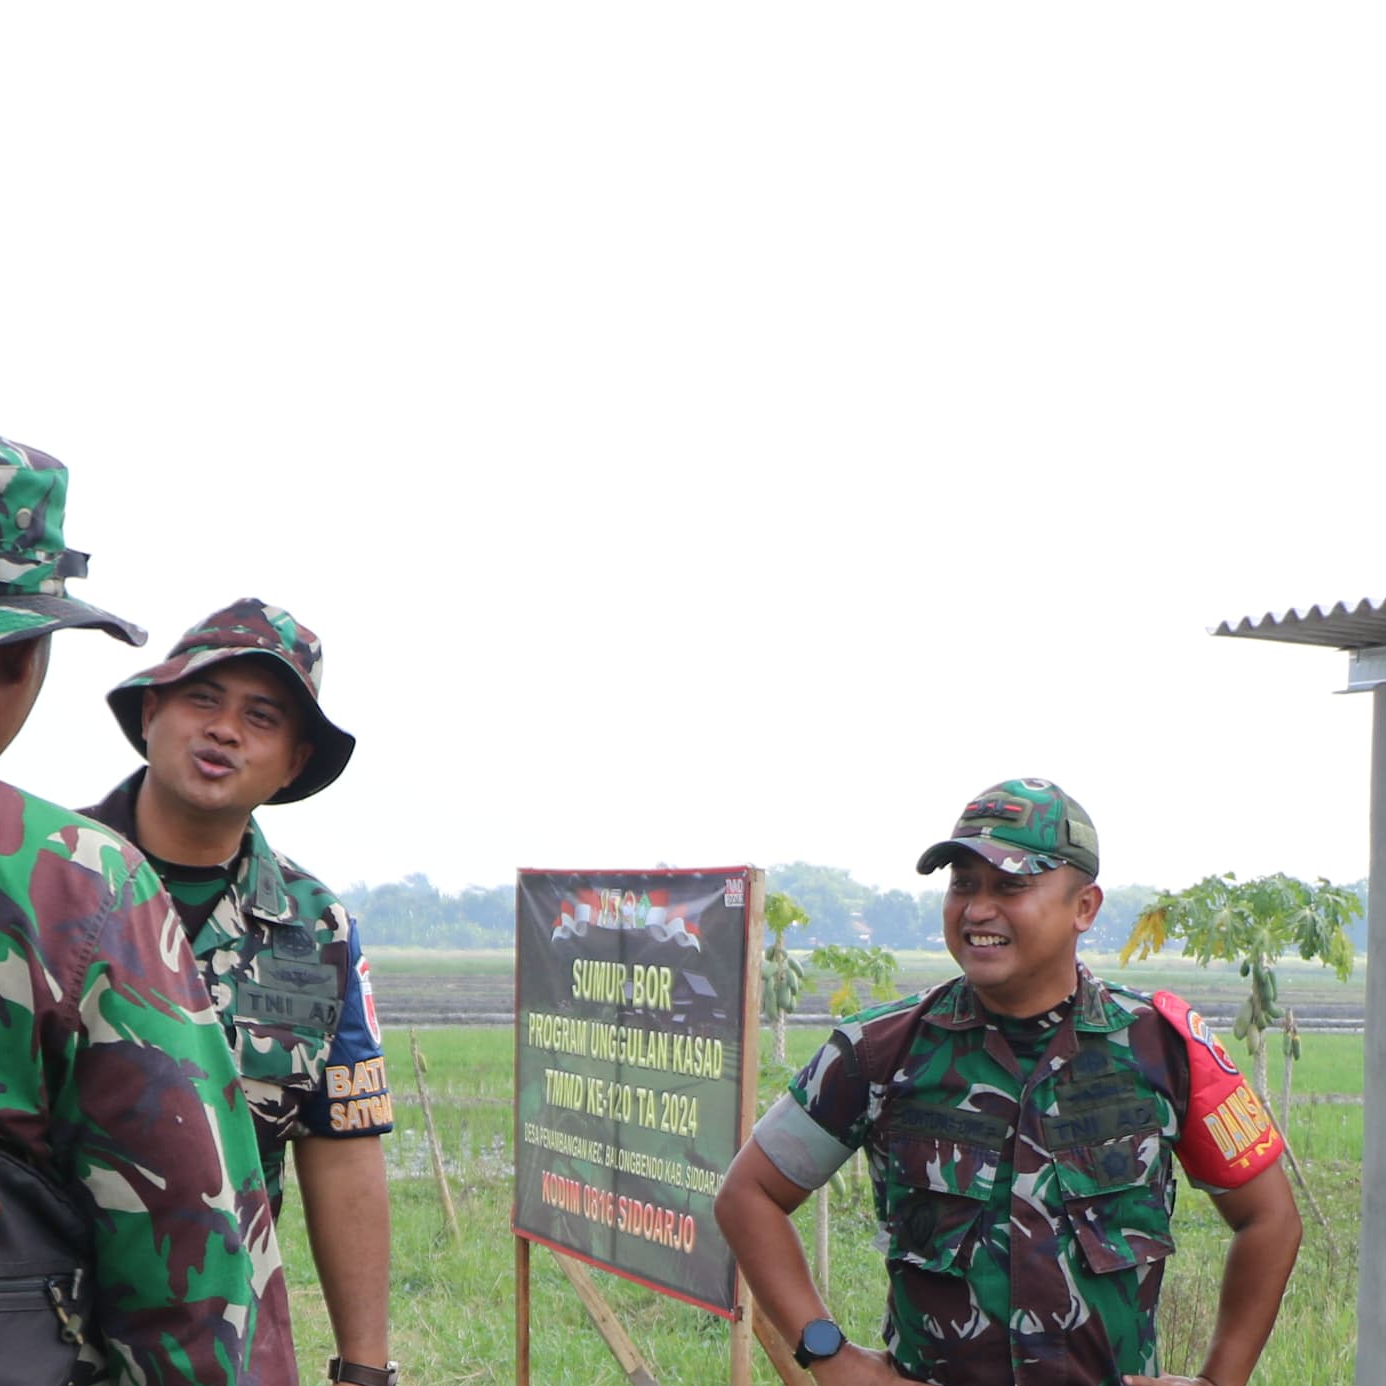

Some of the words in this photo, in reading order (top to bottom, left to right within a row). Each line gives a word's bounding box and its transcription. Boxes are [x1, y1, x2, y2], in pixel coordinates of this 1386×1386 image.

[247, 992, 294, 1016] TNI
[310, 1004, 338, 1026] AD
[572, 958, 627, 1006] SUMUR
[632, 964, 673, 1012] BOR
[528, 1012, 587, 1056] PROGRAM
[591, 1022, 668, 1070] UNGGULAN
[672, 1033, 724, 1080] KASAD
[544, 1068, 584, 1112] TMMD
[586, 1077, 632, 1124] KE-120
[636, 1087, 656, 1130] TA
[660, 1092, 698, 1138] 2024
[1053, 1116, 1099, 1141] TNI
[1116, 1105, 1152, 1127] AD
[524, 1122, 541, 1147] DESA
[588, 1138, 604, 1166] KEC.
[605, 1145, 663, 1182] BALONGBENDO
[664, 1160, 684, 1188] KAB.
[542, 1170, 582, 1216] KODIM
[583, 1184, 614, 1228] 0816
[617, 1195, 696, 1254] SIDOARJO
